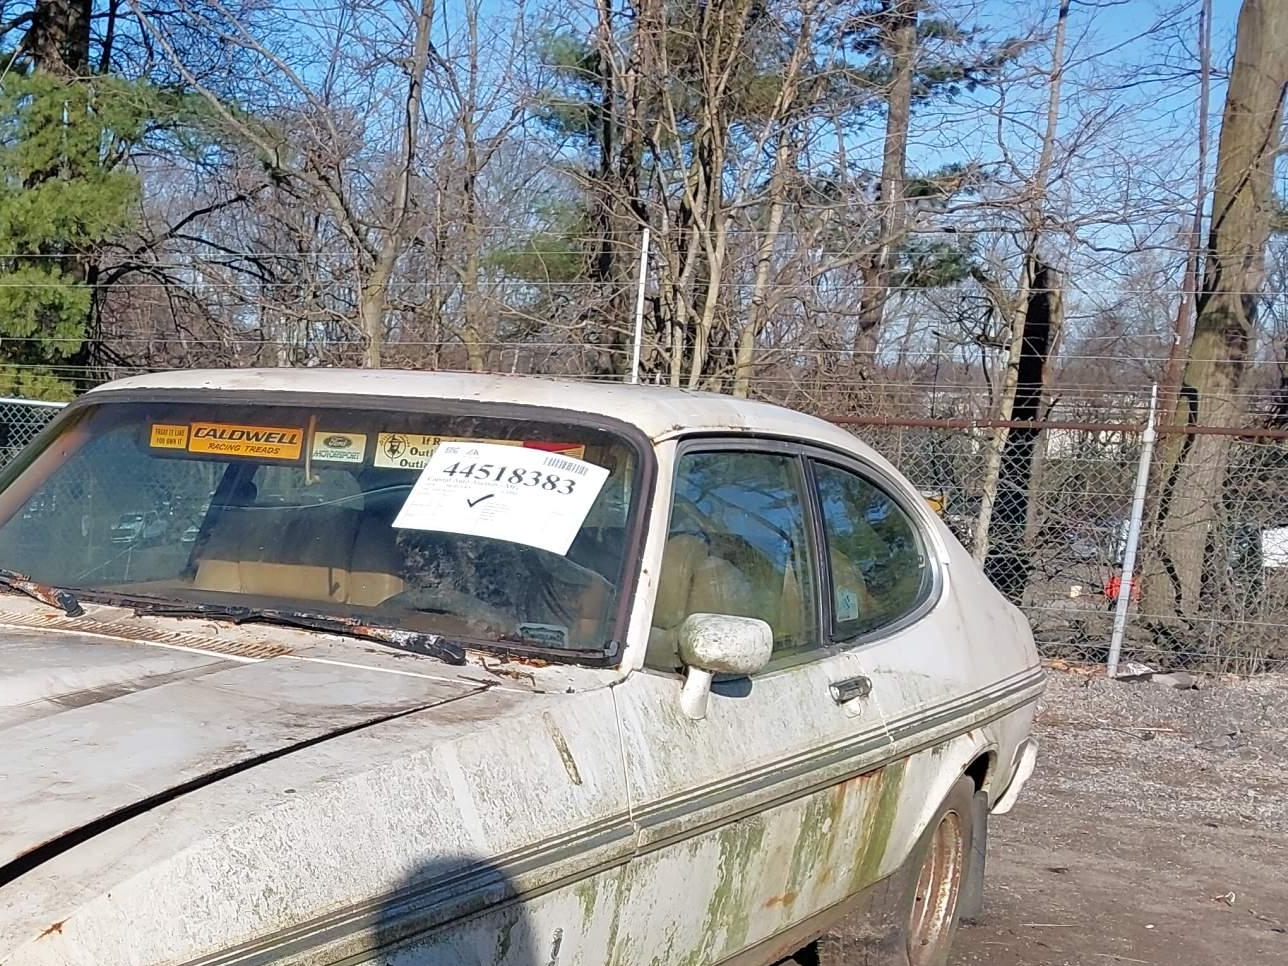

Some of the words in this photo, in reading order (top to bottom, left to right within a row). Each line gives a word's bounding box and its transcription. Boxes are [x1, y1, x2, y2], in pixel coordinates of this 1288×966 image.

[194, 428, 298, 444] CALDWELL
[422, 437, 431, 445] If
[208, 443, 241, 452] RACING
[245, 445, 280, 455] TREADS
[313, 449, 361, 460] MOTORSPORT
[410, 447, 434, 458] Outl
[400, 459, 428, 469] Outla
[443, 462, 576, 496] 44518383
